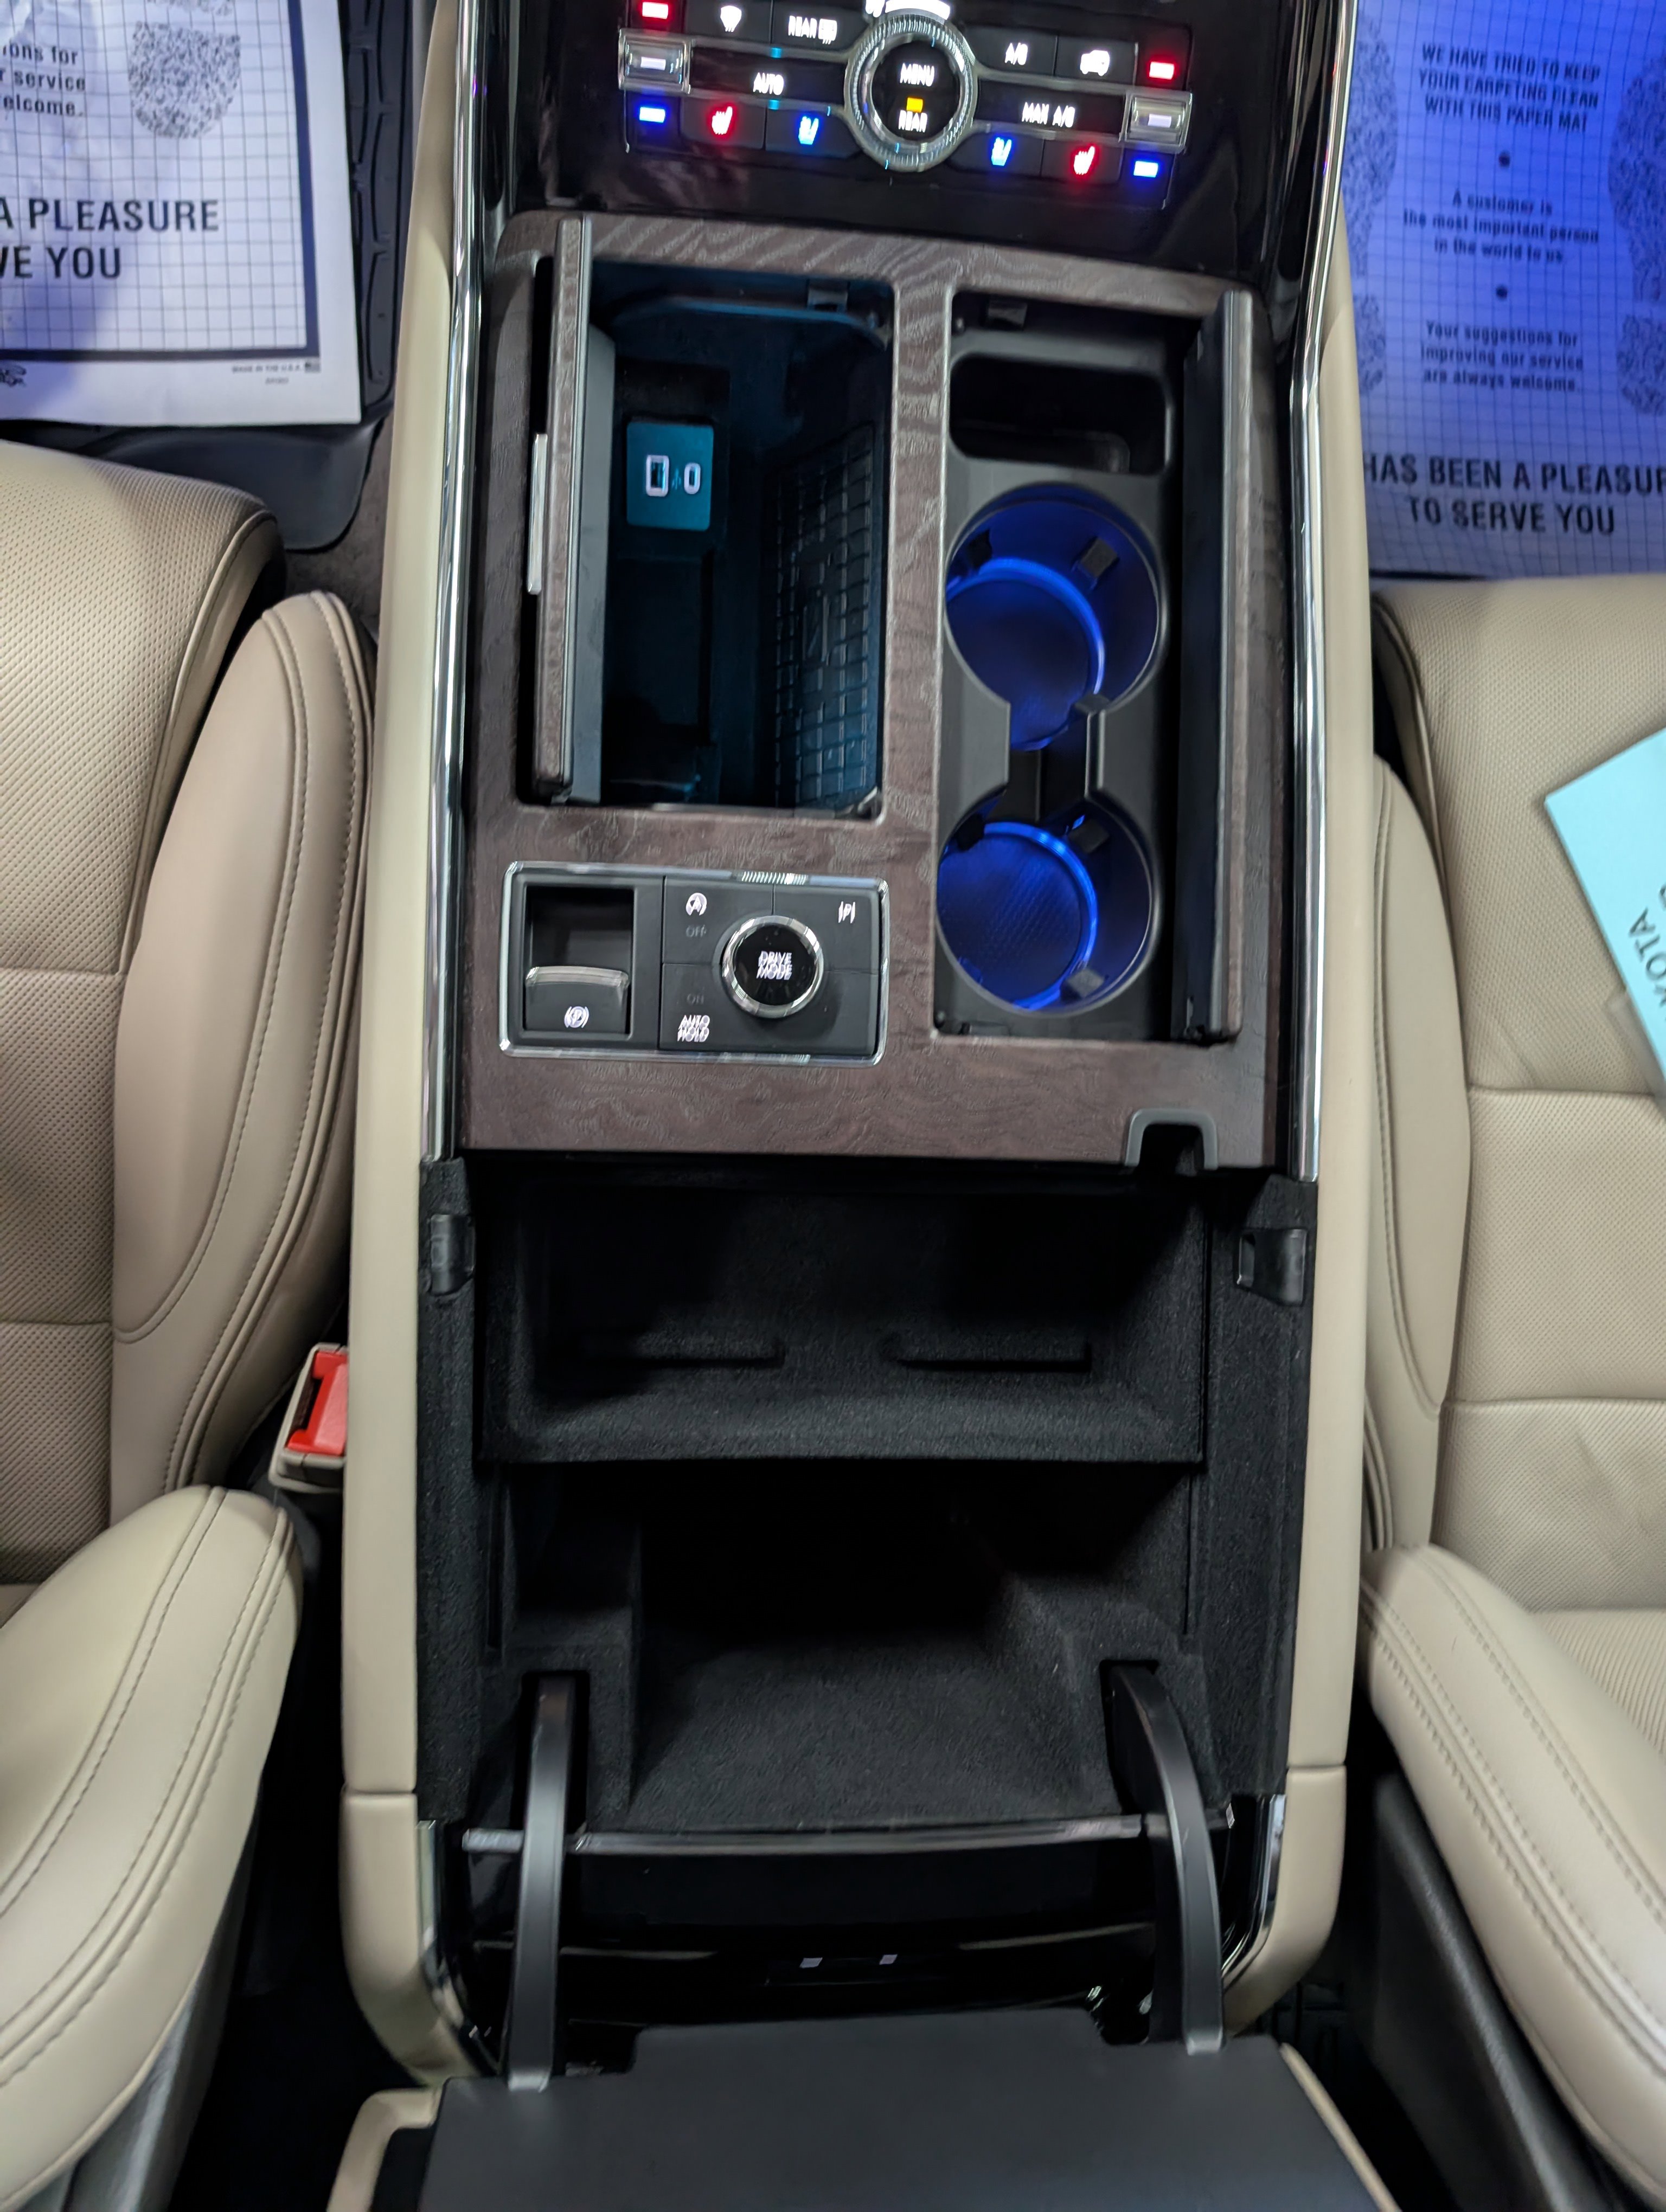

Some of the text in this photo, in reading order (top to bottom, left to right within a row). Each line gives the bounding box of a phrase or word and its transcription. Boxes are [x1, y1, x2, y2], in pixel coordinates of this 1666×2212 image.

[52, 46, 78, 65] for
[14, 70, 85, 92] service
[753, 72, 784, 95] AUTO
[900, 63, 935, 87] MENU
[1022, 102, 1049, 125] MAX
[1453, 188, 1552, 216] A customer is
[29, 197, 219, 232] PLEASURE
[1404, 208, 1599, 244] the most important person
[1434, 236, 1447, 254] in
[1454, 237, 1476, 255] the
[1482, 242, 1522, 261] world
[1527, 244, 1541, 262] to
[47, 246, 121, 279] YOU
[1426, 320, 1577, 347] Your suggestions for
[1420, 342, 1584, 371] improving our service
[1424, 369, 1447, 384] are
[1453, 370, 1504, 390] always
[1429, 456, 1501, 489] BEEN
[1513, 461, 1530, 491] A
[1409, 495, 1615, 536] TO SERVE YOU
[686, 924, 707, 937] OFF
[758, 951, 792, 967] DRIVE
[757, 964, 793, 980] MODE
[678, 1015, 710, 1030] AUTO
[677, 1026, 710, 1043] HOLD
